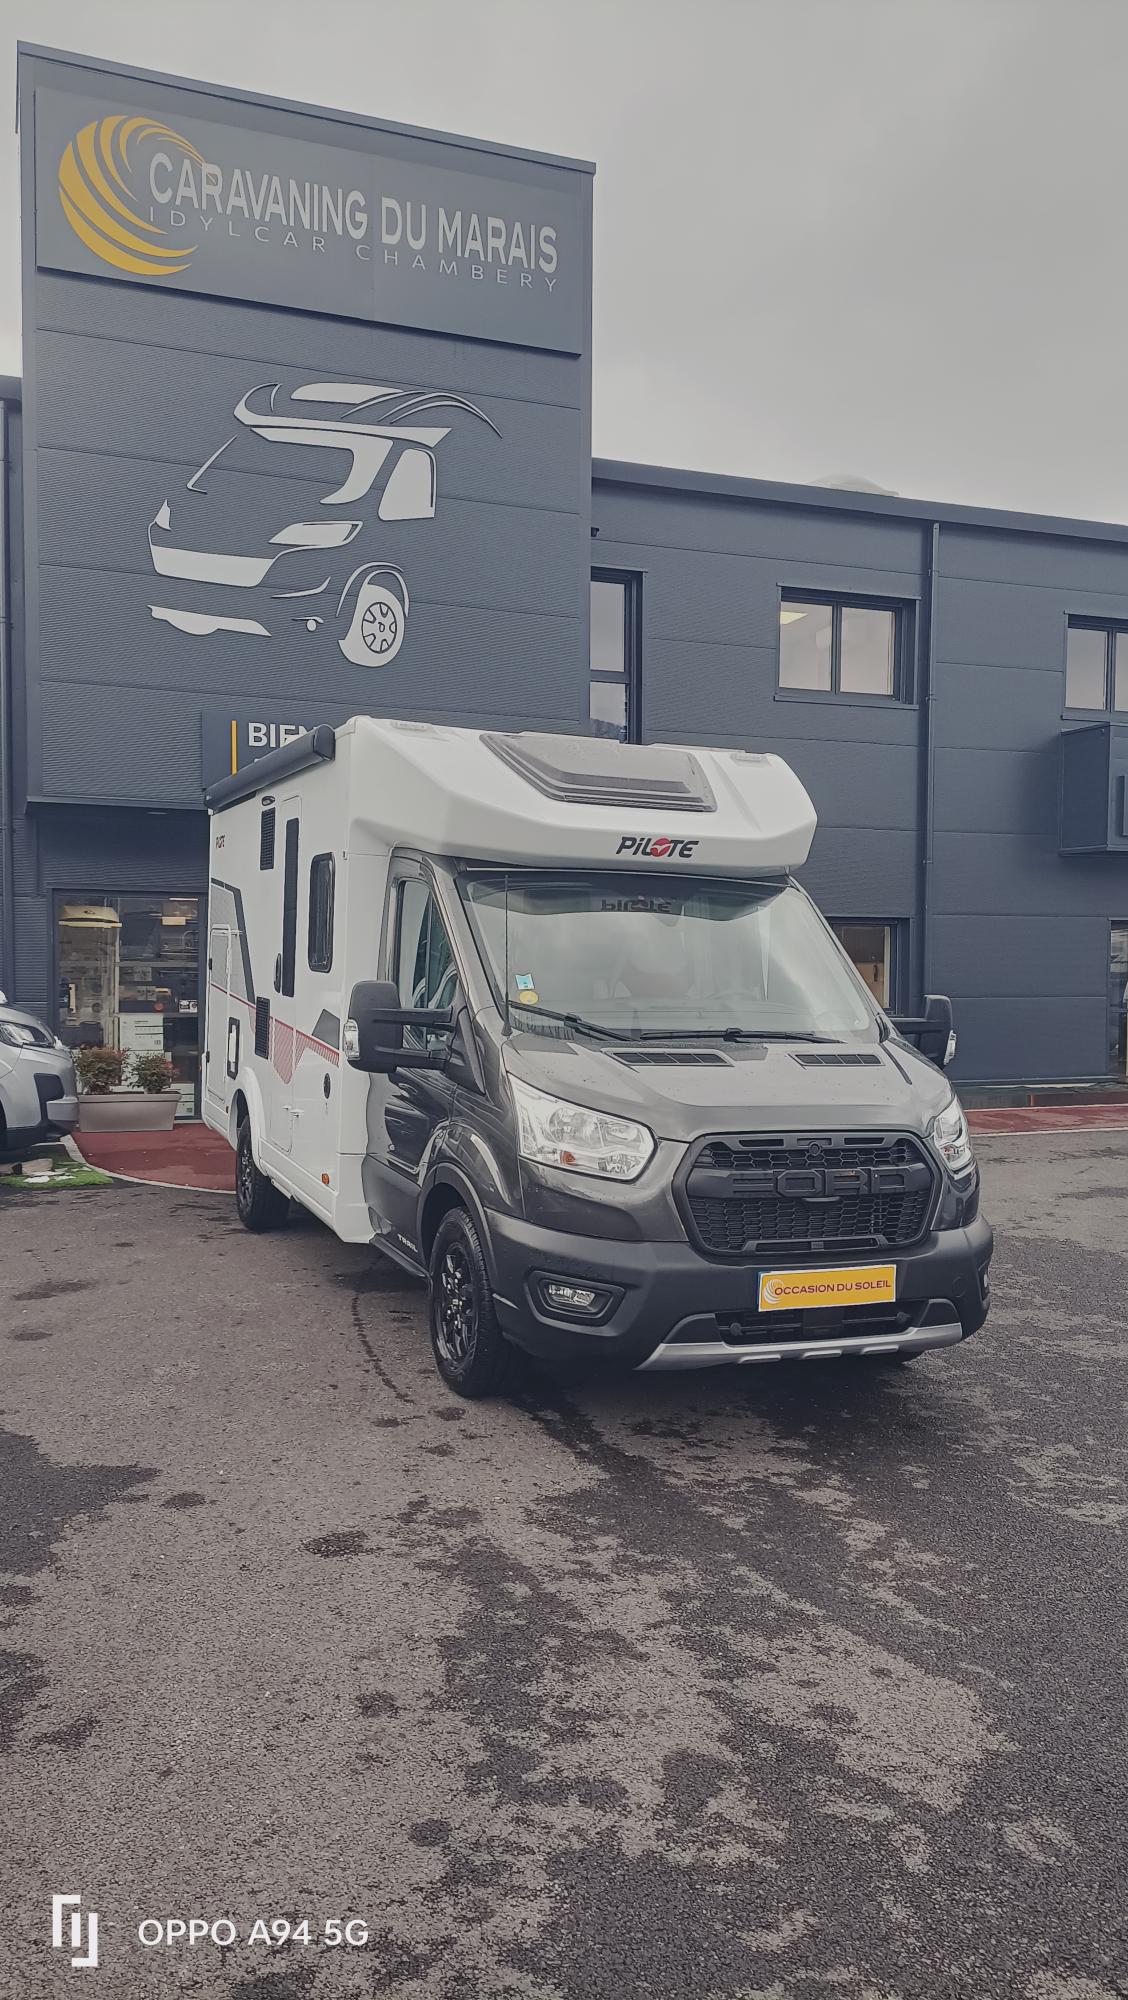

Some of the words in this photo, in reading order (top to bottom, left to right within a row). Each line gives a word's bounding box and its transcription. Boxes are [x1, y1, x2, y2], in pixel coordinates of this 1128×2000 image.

[149, 152, 369, 240] CARAVANING
[381, 196, 427, 250] DU
[438, 207, 559, 274] MARAIS
[149, 206, 326, 252] IDYLCAR
[355, 244, 558, 292] CHAMBERY
[728, 1166, 910, 1198] FORD
[774, 1284, 835, 1296] OCCASION
[836, 1282, 853, 1292] DU
[854, 1280, 892, 1290] SOLEIL
